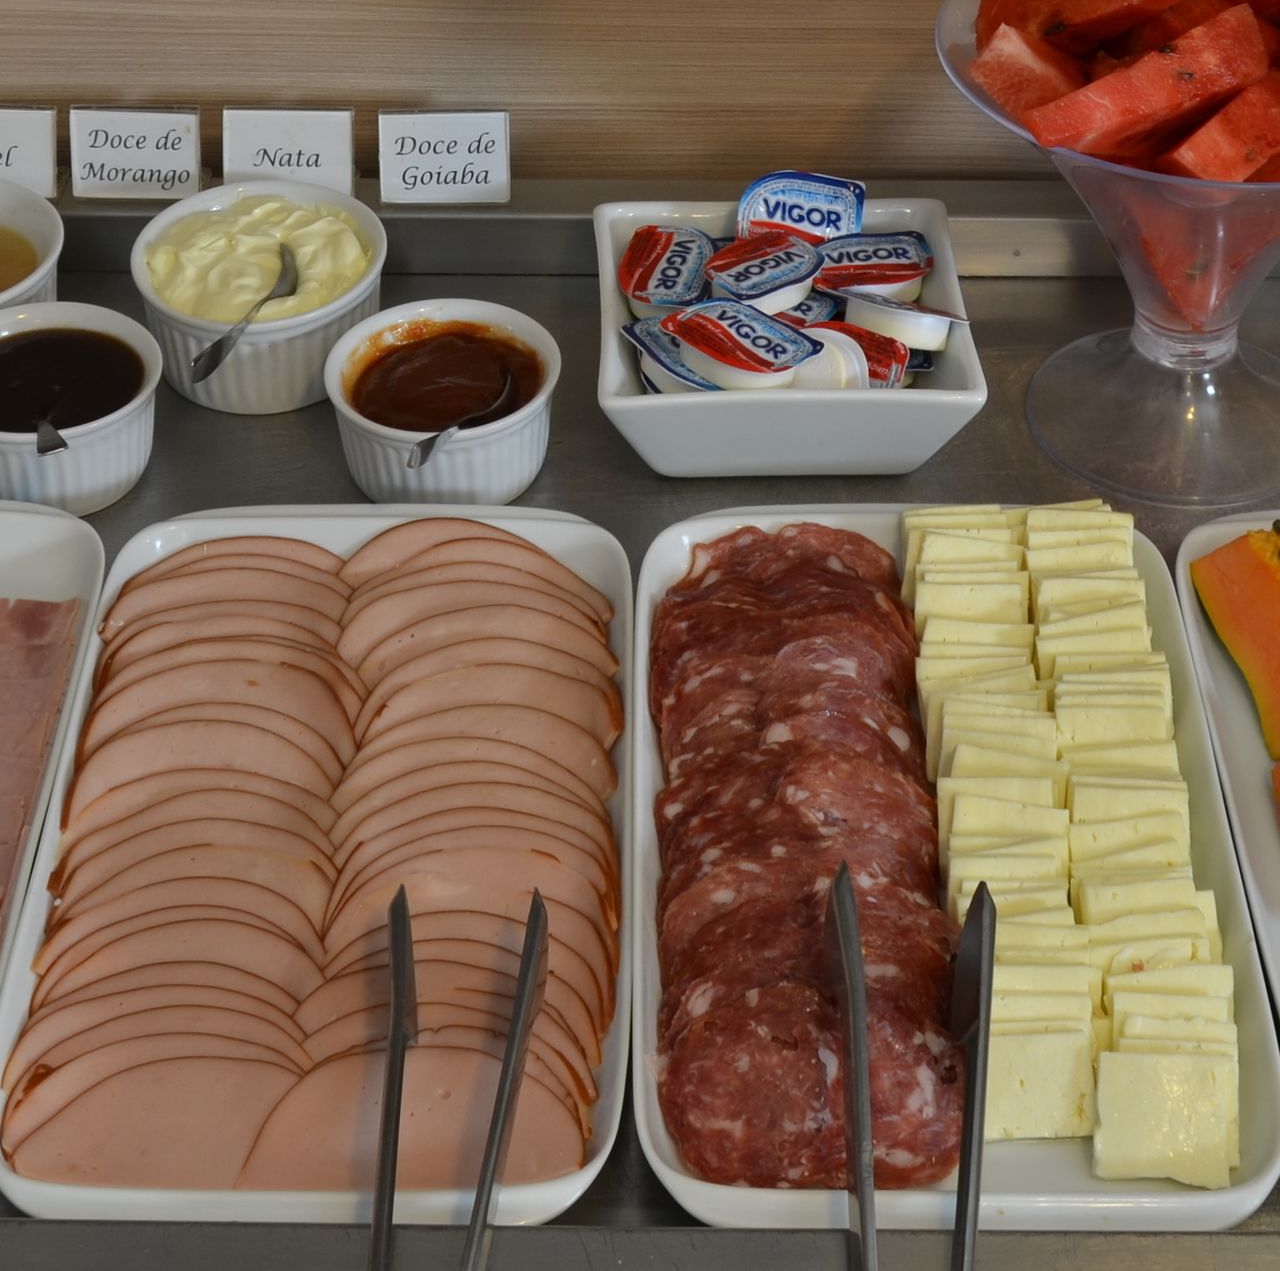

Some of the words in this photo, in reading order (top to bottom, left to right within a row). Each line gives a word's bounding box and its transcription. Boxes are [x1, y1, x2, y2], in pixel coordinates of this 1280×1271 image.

[88, 128, 147, 150] Doce
[155, 129, 182, 152] de
[394, 134, 458, 156] Doce
[467, 132, 496, 155] de
[252, 147, 322, 168] Nata
[80, 162, 191, 190] Morango
[401, 162, 492, 190] Goiaba
[763, 197, 842, 230] VIGOR
[654, 239, 696, 290] VIGOR
[728, 251, 805, 283] VIGOR
[825, 246, 913, 264] VIGOR
[717, 309, 788, 359] VIGOR
